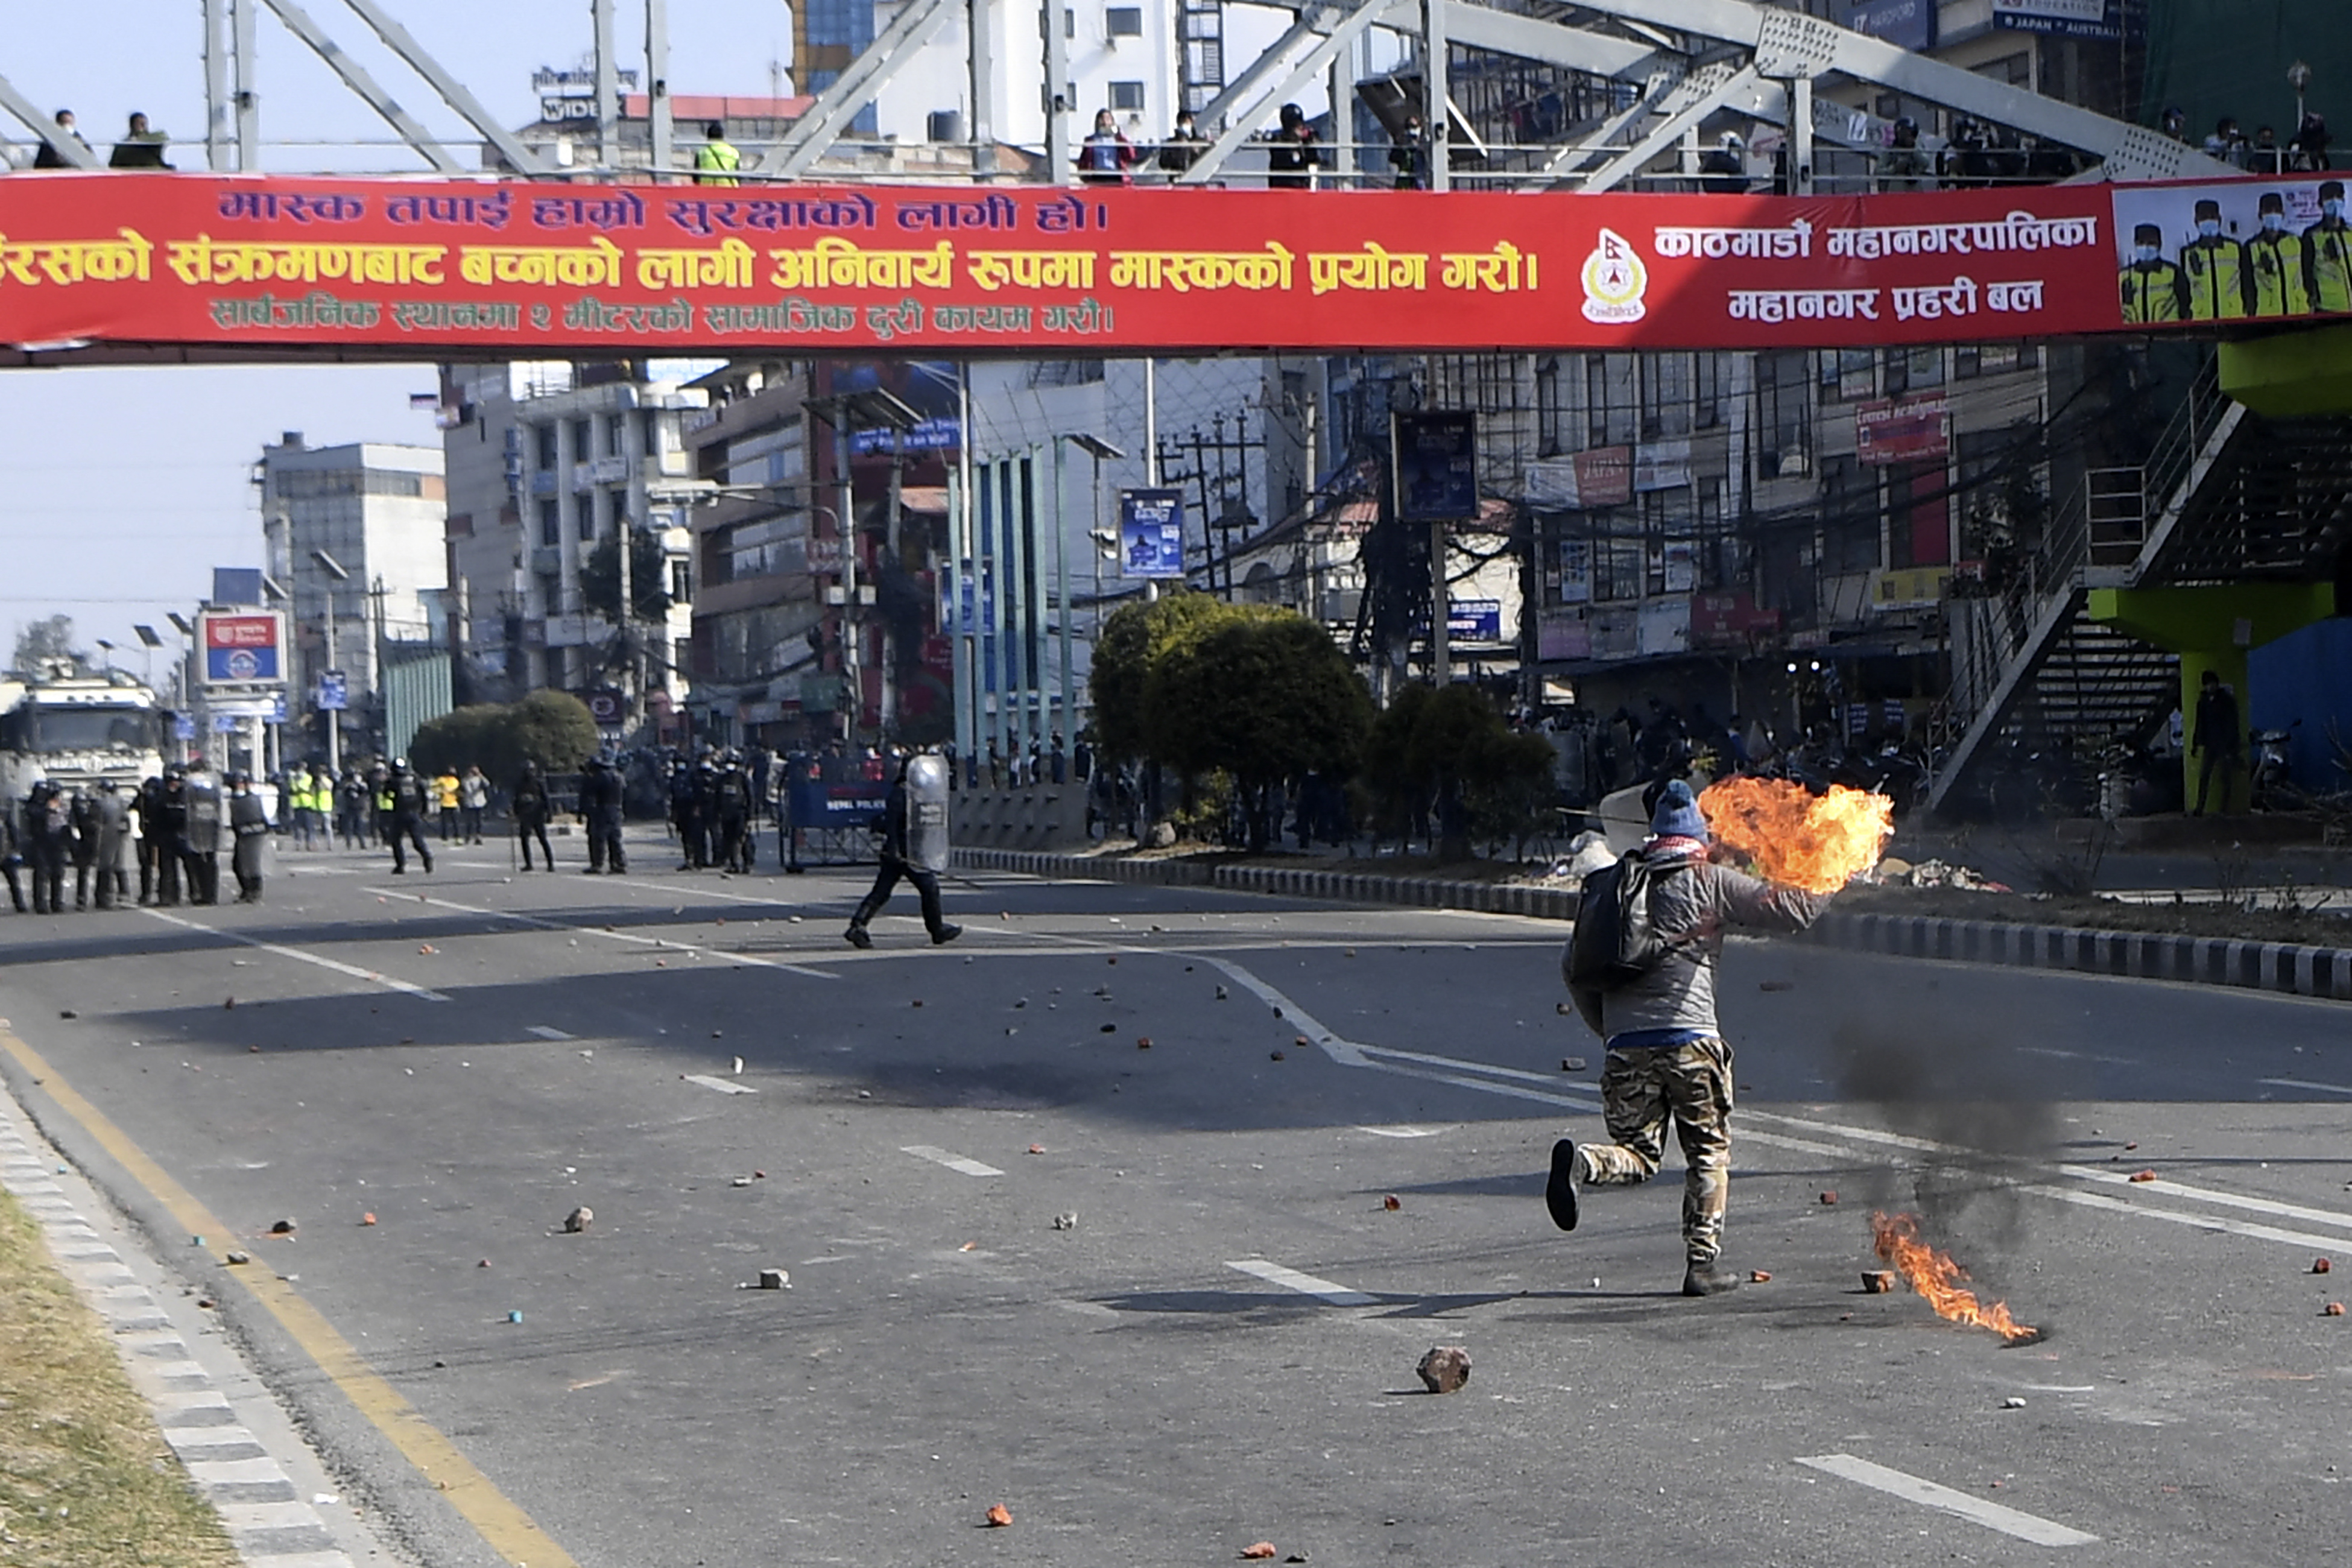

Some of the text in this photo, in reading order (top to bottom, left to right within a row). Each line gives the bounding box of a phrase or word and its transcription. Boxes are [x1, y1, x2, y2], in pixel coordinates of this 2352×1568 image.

[2015, 17, 2127, 38] JAPAN AUSTRALI
[218, 192, 367, 225] मास्क
[665, 193, 879, 236] सुरक्षाको
[894, 194, 1021, 232] लागी
[1827, 210, 2098, 259] महानगरपालिका
[166, 232, 449, 286] संक्रमणबाट
[459, 236, 624, 287] बच्नको
[637, 237, 757, 289] लागी
[769, 236, 955, 289] अनिवार्य
[1109, 240, 1295, 293] मास्कको
[1307, 240, 1429, 296] प्रयोग
[391, 302, 520, 332] स्थानमा
[703, 296, 857, 334] सामाजिक
[933, 304, 1034, 333] कायम
[1727, 275, 2044, 323] महानगर प्रहरी बल
